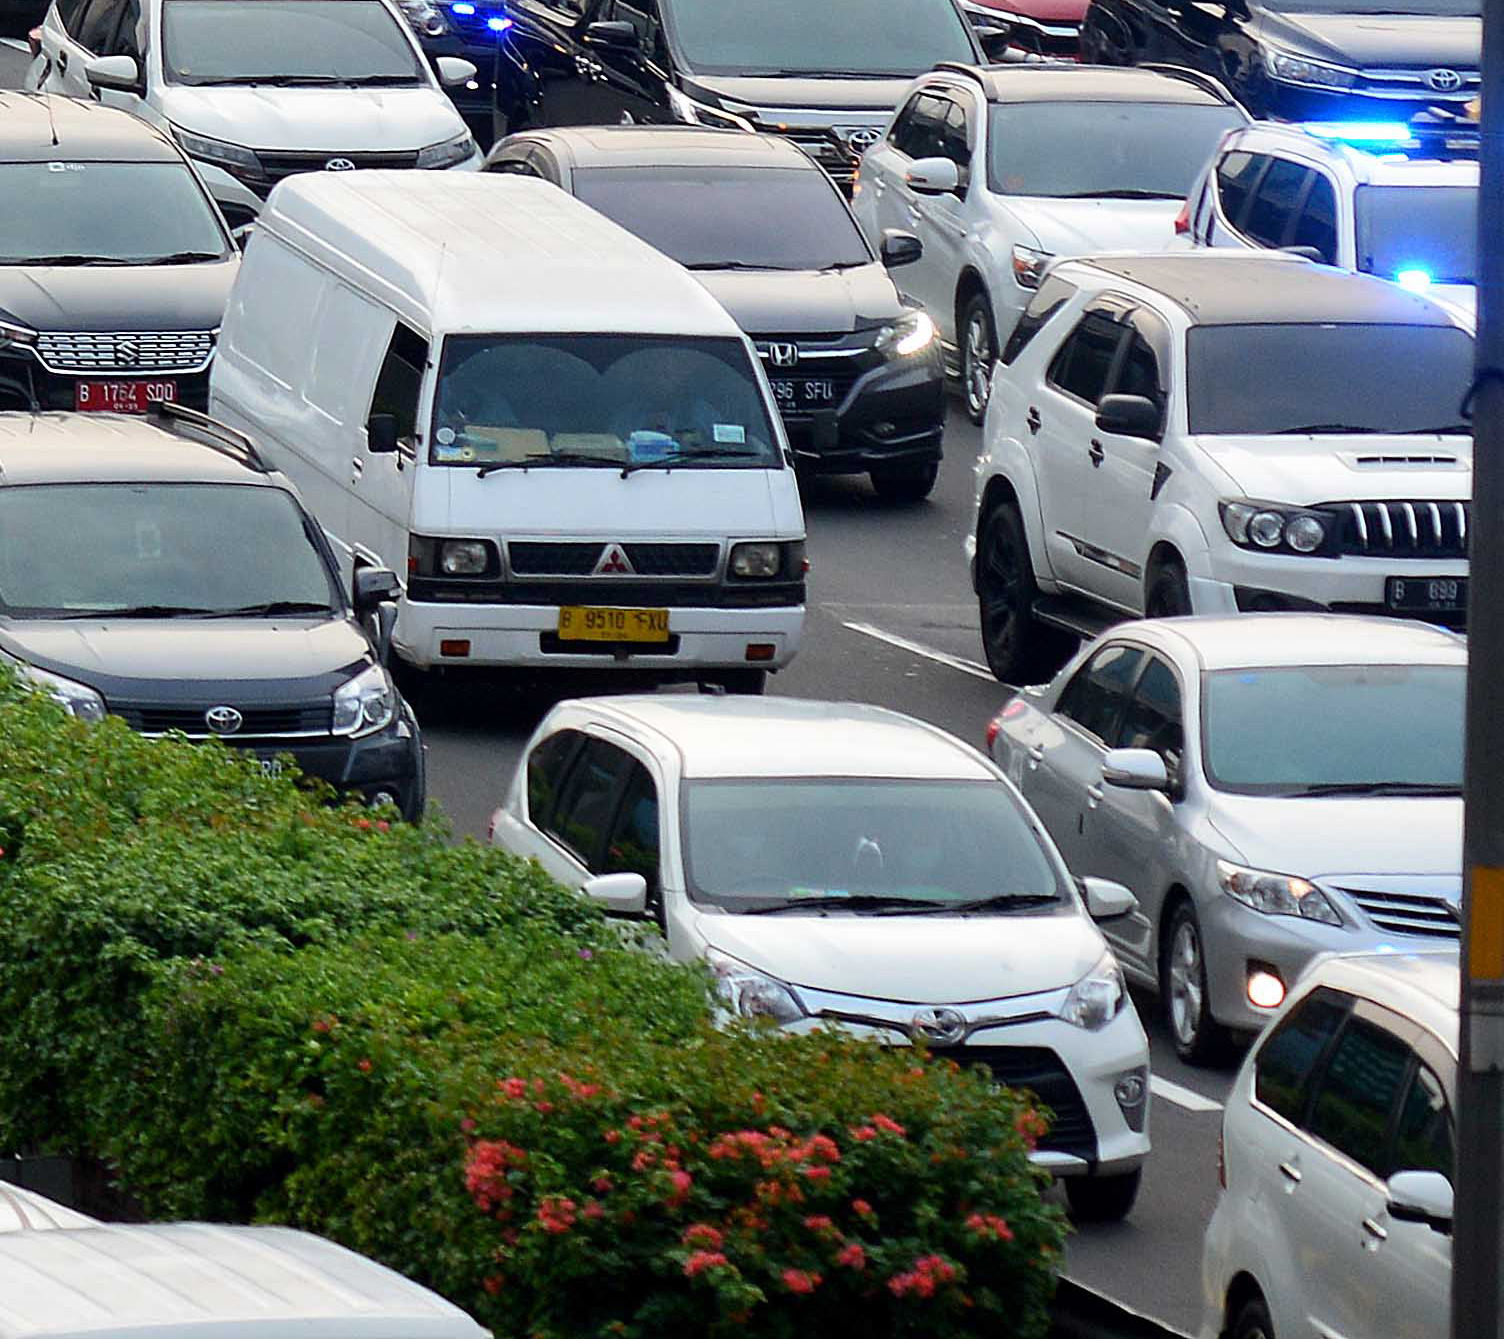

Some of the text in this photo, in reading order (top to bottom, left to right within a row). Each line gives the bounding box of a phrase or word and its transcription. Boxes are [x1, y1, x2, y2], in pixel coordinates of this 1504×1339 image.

[80, 384, 90, 402] B
[1394, 581, 1405, 600] B
[562, 610, 668, 630] B 9510 FXU
